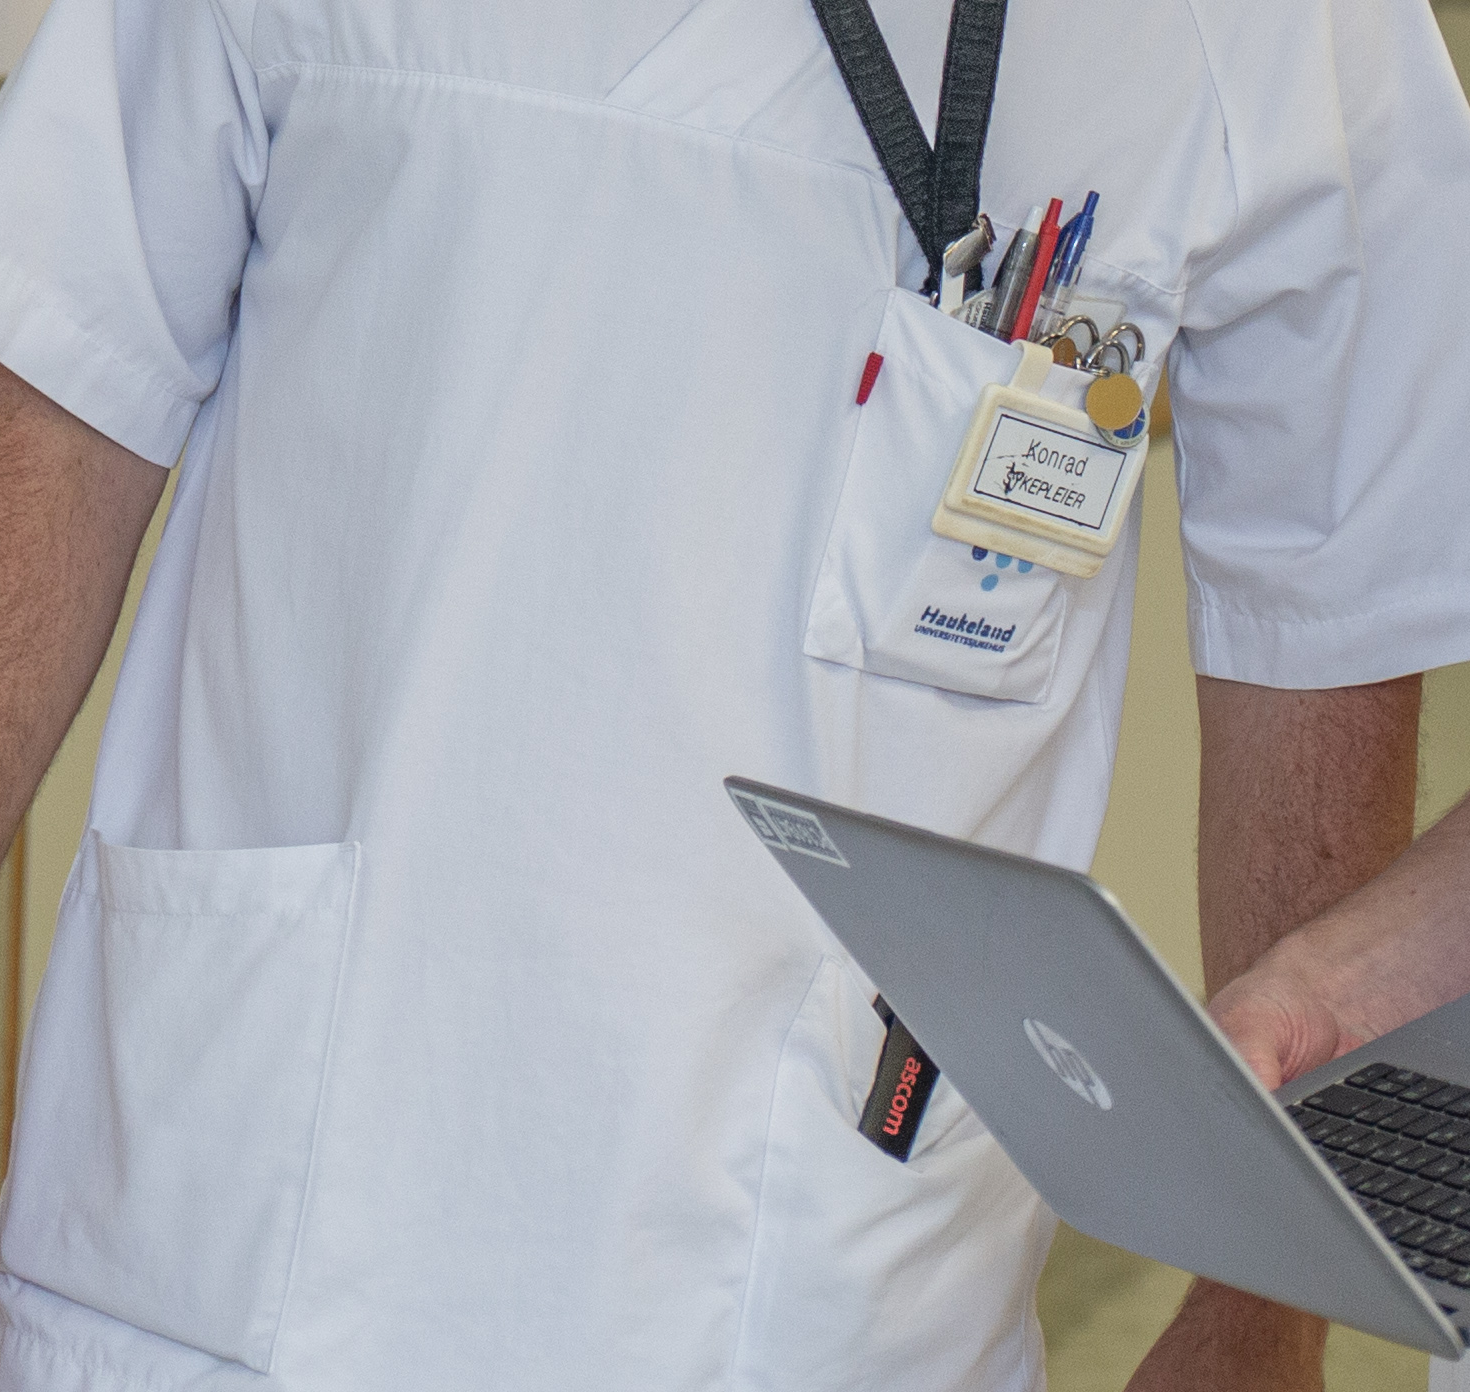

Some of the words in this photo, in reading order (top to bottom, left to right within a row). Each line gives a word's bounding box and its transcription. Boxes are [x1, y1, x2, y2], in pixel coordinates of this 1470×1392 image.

[1026, 438, 1089, 477] Konrad
[920, 605, 1017, 643] Haukeland
[883, 1057, 922, 1135] ascom
